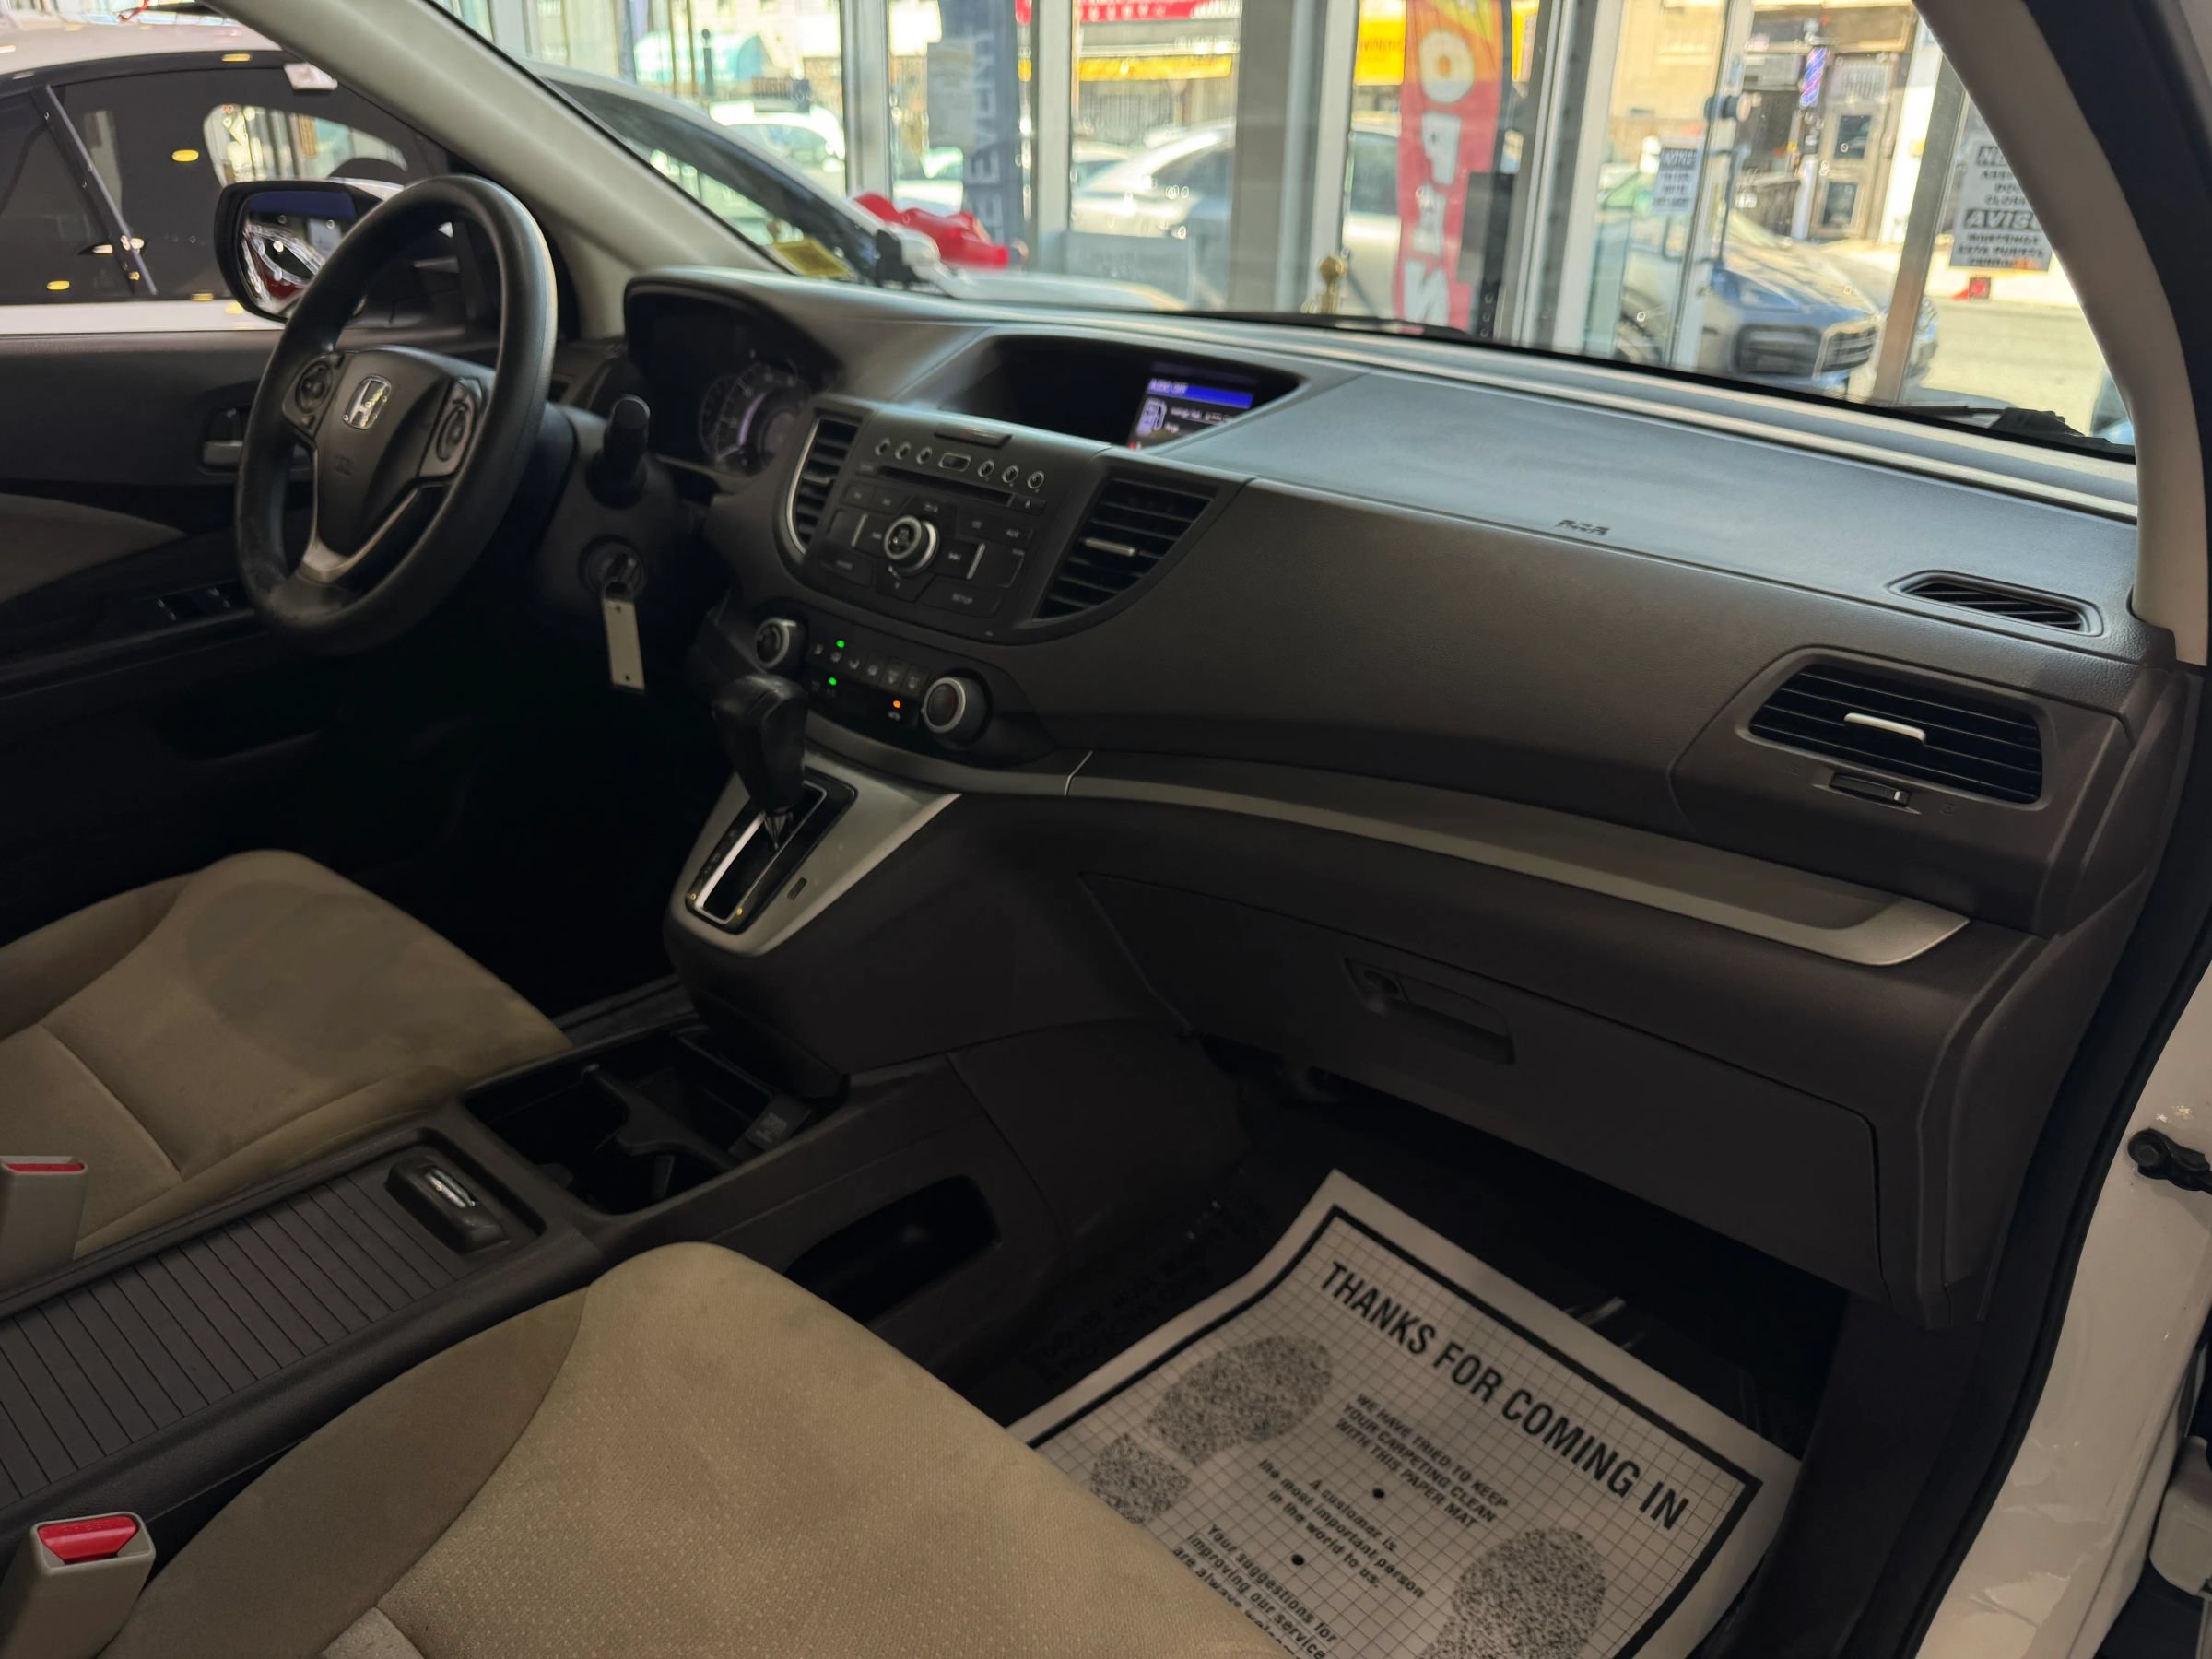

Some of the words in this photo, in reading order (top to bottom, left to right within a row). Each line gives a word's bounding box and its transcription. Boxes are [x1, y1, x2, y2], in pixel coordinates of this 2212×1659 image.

[1321, 1262, 1437, 1357] THANKS
[1432, 1341, 1503, 1404] FOR
[1500, 1386, 1641, 1500] COMING
[1639, 1480, 1689, 1531] IN
[1357, 1394, 1380, 1413] WE
[1377, 1409, 1414, 1439] HAVE
[1413, 1435, 1453, 1468] TRIED
[1453, 1465, 1474, 1484] TO
[1471, 1480, 1509, 1509] KEEP
[1310, 1479, 1322, 1490] A
[1320, 1488, 1383, 1539] customer
[1336, 1418, 1371, 1447] WITH
[1369, 1445, 1402, 1472] THIS
[1400, 1468, 1445, 1506] PAPER
[1444, 1502, 1478, 1529] MAT
[1343, 1403, 1380, 1433] YOUR
[1378, 1430, 1452, 1488] CARPETING
[1450, 1486, 1498, 1524] CLEAN
[1172, 1546, 1196, 1568] are
[1207, 1524, 1238, 1553] Your
[1235, 1552, 1315, 1625] suggestions
[1313, 1620, 1338, 1644] for
[1258, 1459, 1280, 1479] the
[1279, 1478, 1315, 1508] most
[1312, 1502, 1379, 1559] important
[1376, 1556, 1426, 1599] person
[1268, 1489, 1283, 1503] in
[1282, 1502, 1306, 1524] the
[1305, 1520, 1346, 1556] world
[1343, 1552, 1360, 1569] to
[1359, 1567, 1381, 1588] us.
[1187, 1533, 1251, 1594] improving
[1250, 1591, 1277, 1615] our
[1274, 1612, 1327, 1659] service
